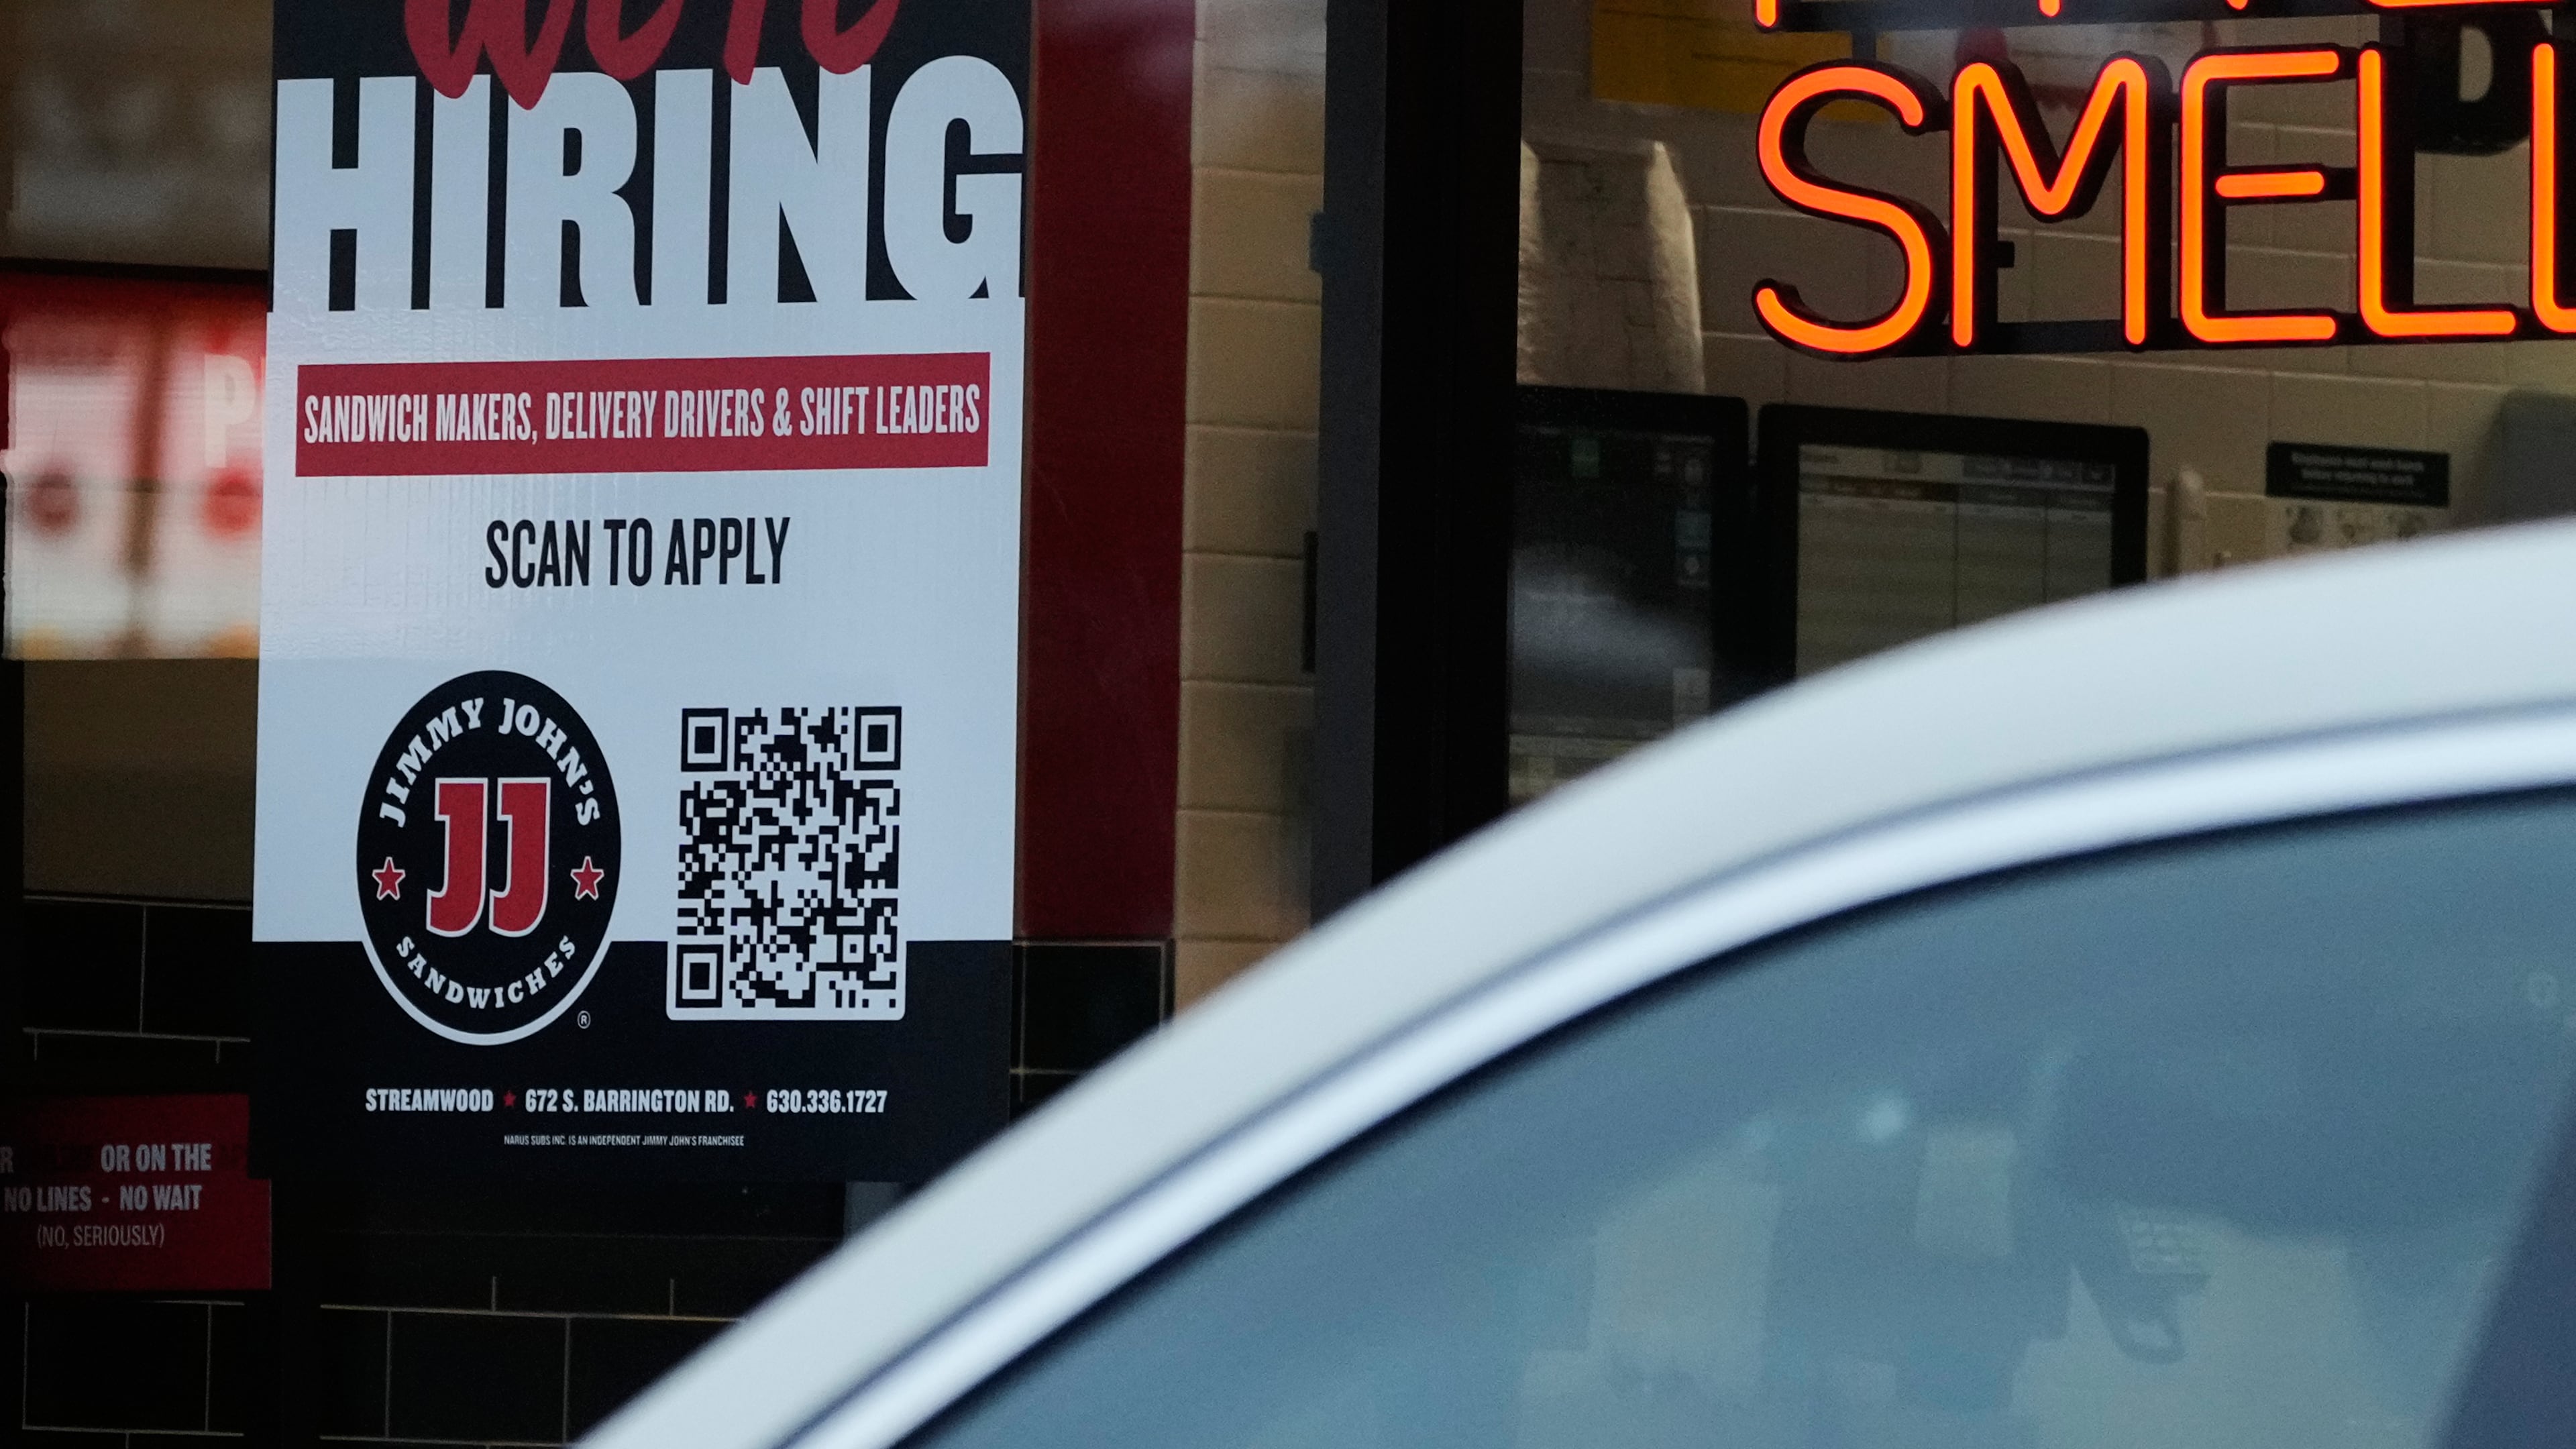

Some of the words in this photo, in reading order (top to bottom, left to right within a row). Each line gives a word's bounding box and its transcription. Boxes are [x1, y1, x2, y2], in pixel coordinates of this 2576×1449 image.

[272, 56, 1024, 312] HIRING
[304, 394, 428, 443] SANDWICH
[435, 392, 537, 445] MAKERS,
[545, 390, 657, 440] DELIVERY
[664, 388, 765, 438] DRIVERS
[772, 387, 793, 437] &
[800, 386, 869, 437] SHIFT
[876, 384, 981, 435] LEADERS
[485, 519, 591, 589] SCAN
[604, 517, 653, 587] TO
[664, 517, 791, 586] APPLY
[379, 697, 484, 828] JIMMY
[498, 697, 601, 826] JOHN'S
[425, 776, 551, 938] JJ
[396, 935, 576, 1009] SANDWICHES
[366, 1088, 494, 1112] STREAMWOOD
[525, 1089, 558, 1113] 672
[562, 1089, 578, 1113] S.
[583, 1089, 700, 1113] BARRINGTON
[704, 1089, 735, 1113] RD.
[767, 1089, 888, 1114] 630.336.1727
[101, 1144, 131, 1173] OR
[136, 1143, 166, 1173] ON
[171, 1143, 212, 1172] THE
[531, 1135, 550, 1146] SUBS
[568, 1135, 576, 1146] IS
[578, 1135, 588, 1146] AN
[589, 1135, 641, 1146] INDEPENDENT
[642, 1135, 667, 1146] JIMMY
[669, 1135, 696, 1146] JOHN'S
[698, 1136, 745, 1146] FRANCHISEE
[3, 1186, 33, 1212] NO
[36, 1185, 93, 1212] LINES
[119, 1185, 149, 1212] NO
[152, 1184, 203, 1211] WAIT
[37, 1223, 70, 1249] (NO,
[73, 1222, 165, 1249] SERIOUSLY)
